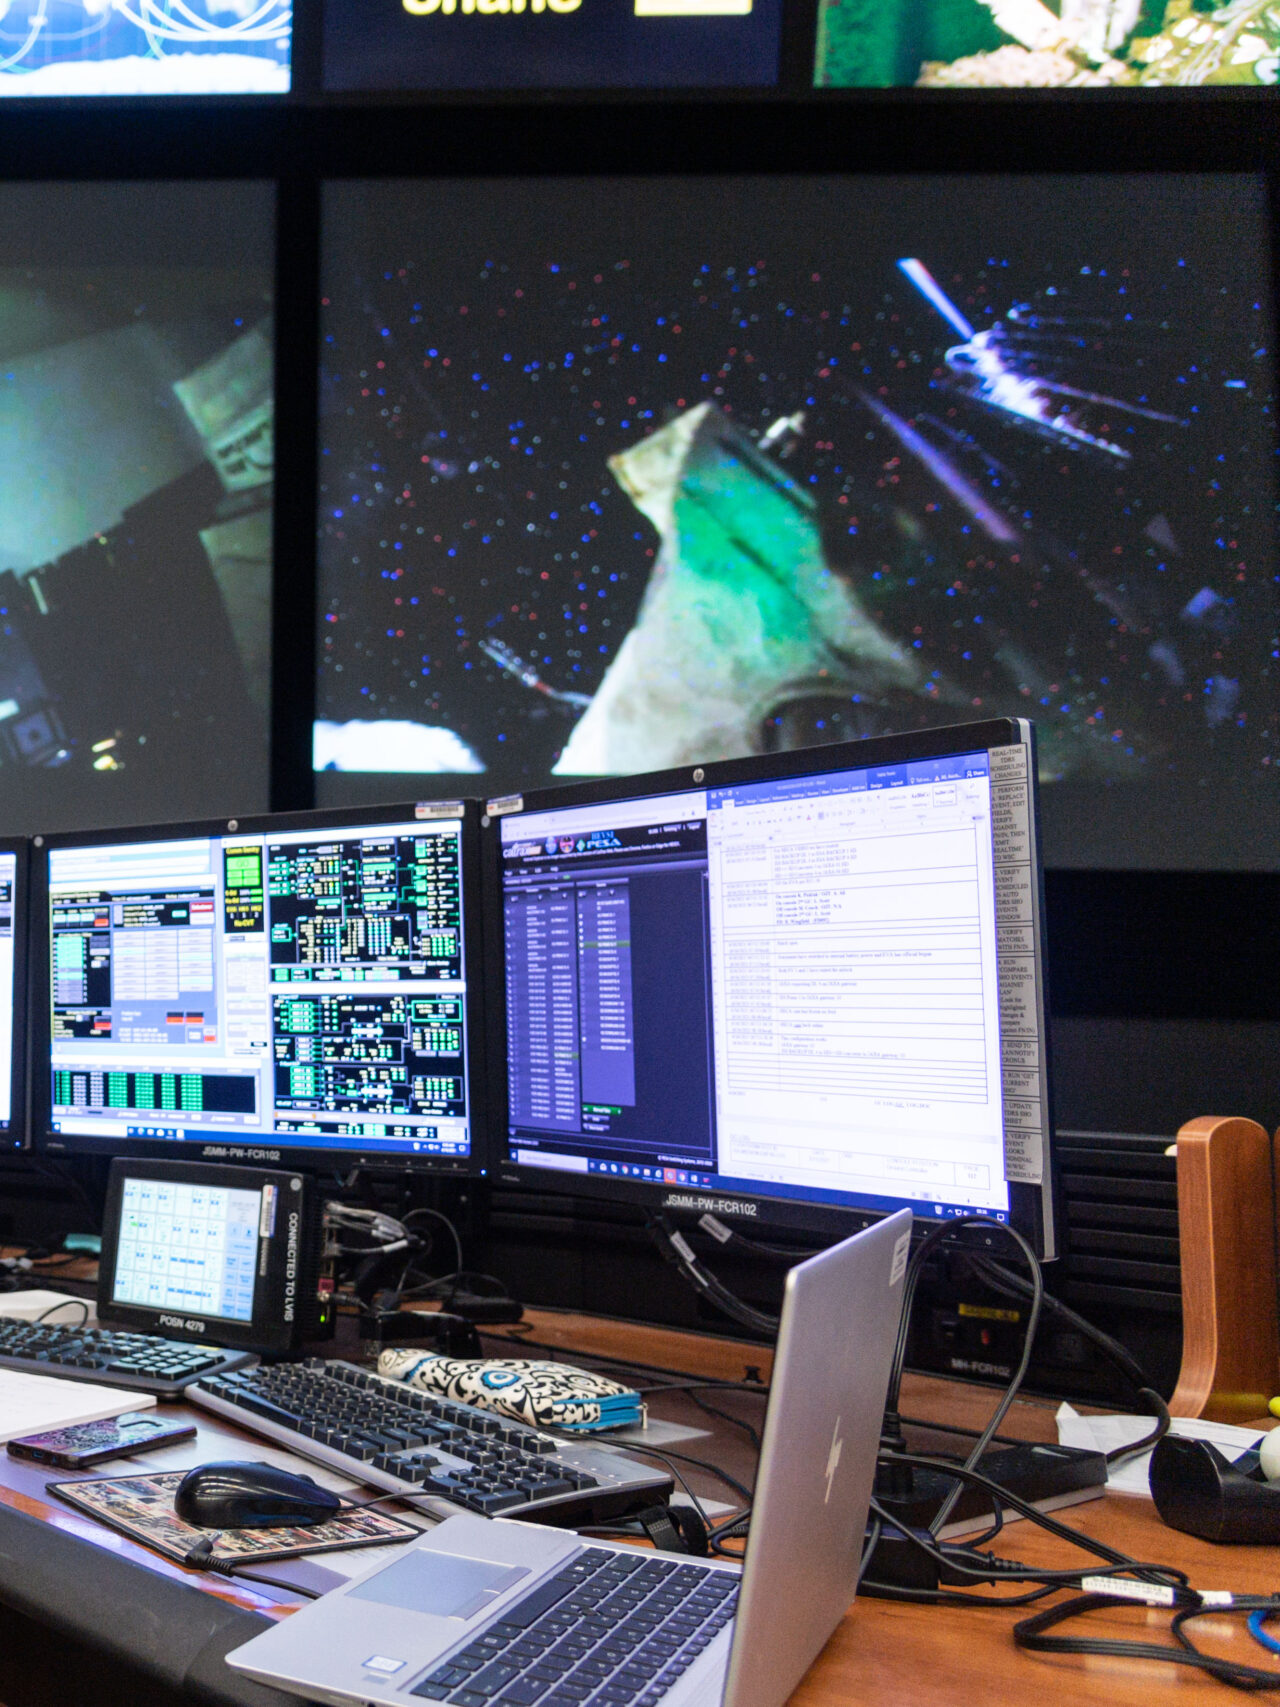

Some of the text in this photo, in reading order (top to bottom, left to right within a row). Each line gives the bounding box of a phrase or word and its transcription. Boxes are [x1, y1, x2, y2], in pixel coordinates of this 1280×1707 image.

[586, 838, 622, 850] PESA
[666, 1194, 757, 1216] JSMM-PW-FCR102
[286, 1212, 299, 1279] CONNECTED
[285, 1280, 296, 1296] TO
